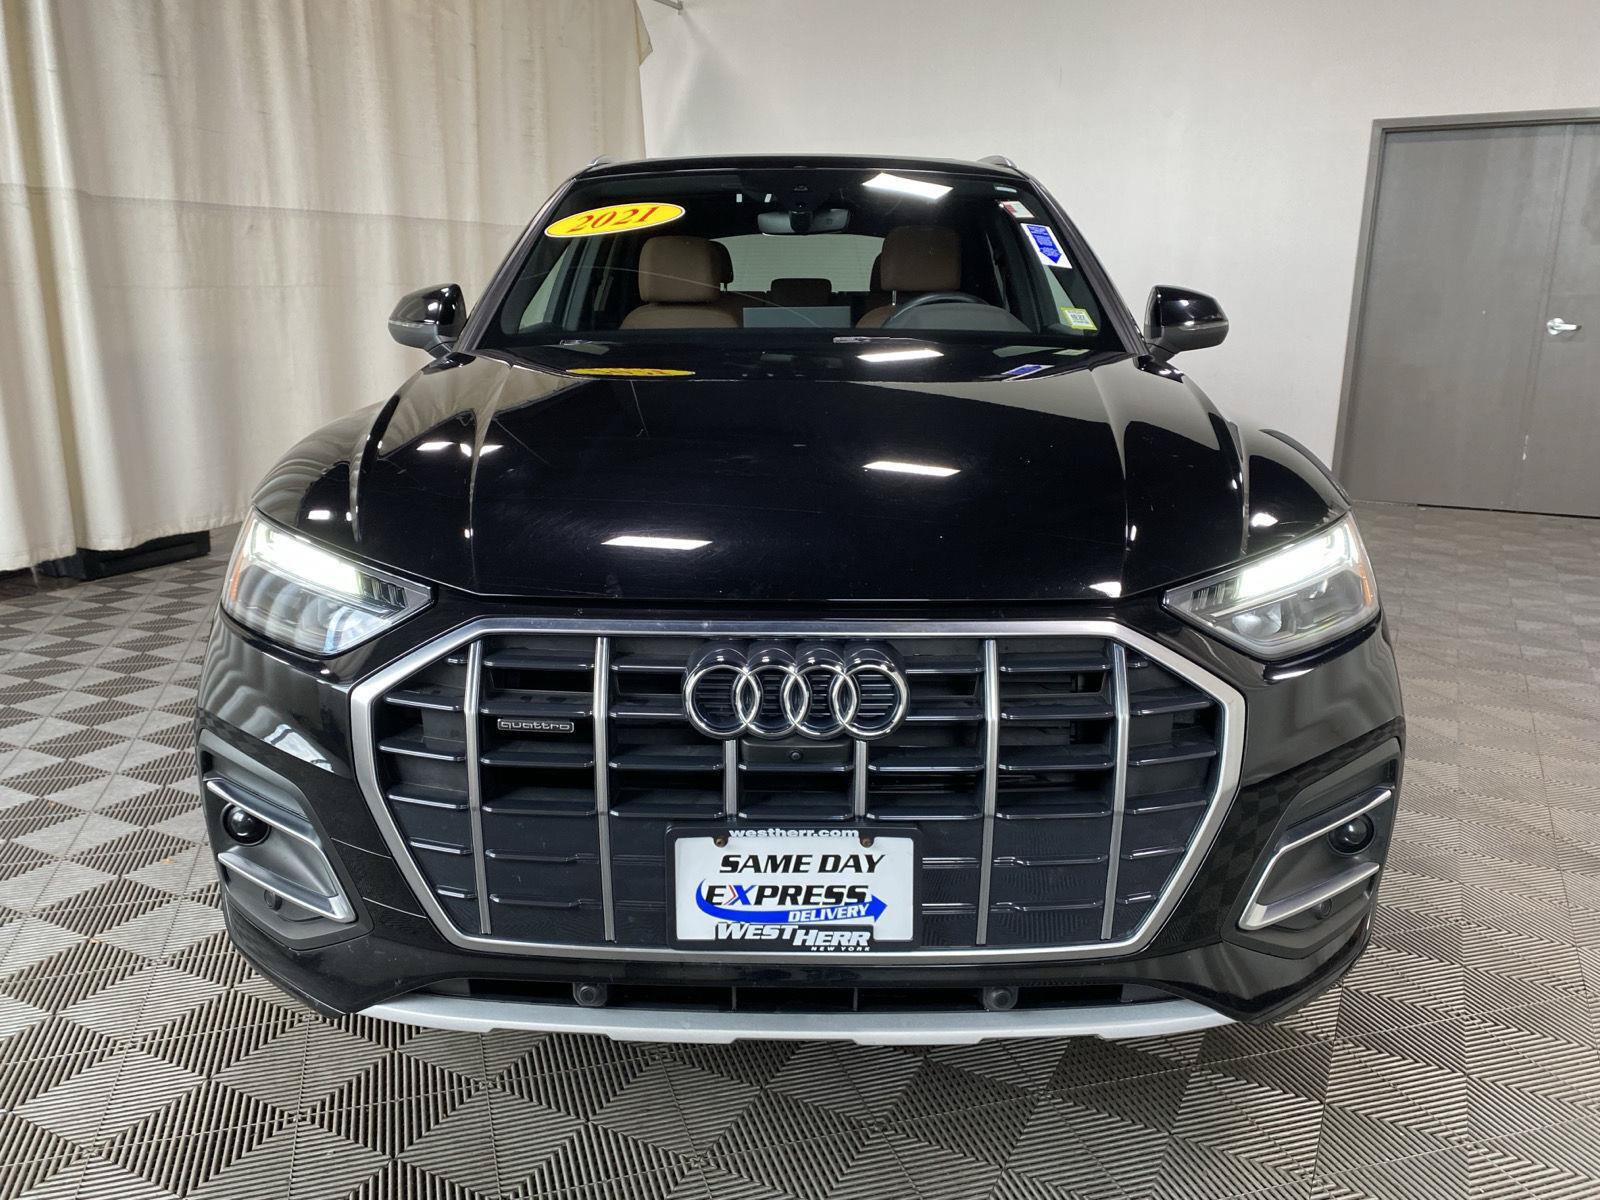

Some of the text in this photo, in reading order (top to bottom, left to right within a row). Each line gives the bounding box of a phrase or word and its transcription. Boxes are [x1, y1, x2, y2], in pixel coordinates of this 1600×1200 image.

[567, 207, 659, 233] 2021
[501, 721, 571, 730] quattro
[729, 829, 859, 838] westherr.com
[719, 854, 886, 873] SAME DAY
[705, 885, 869, 906] EXPRESS
[788, 905, 870, 923] DELIVERY
